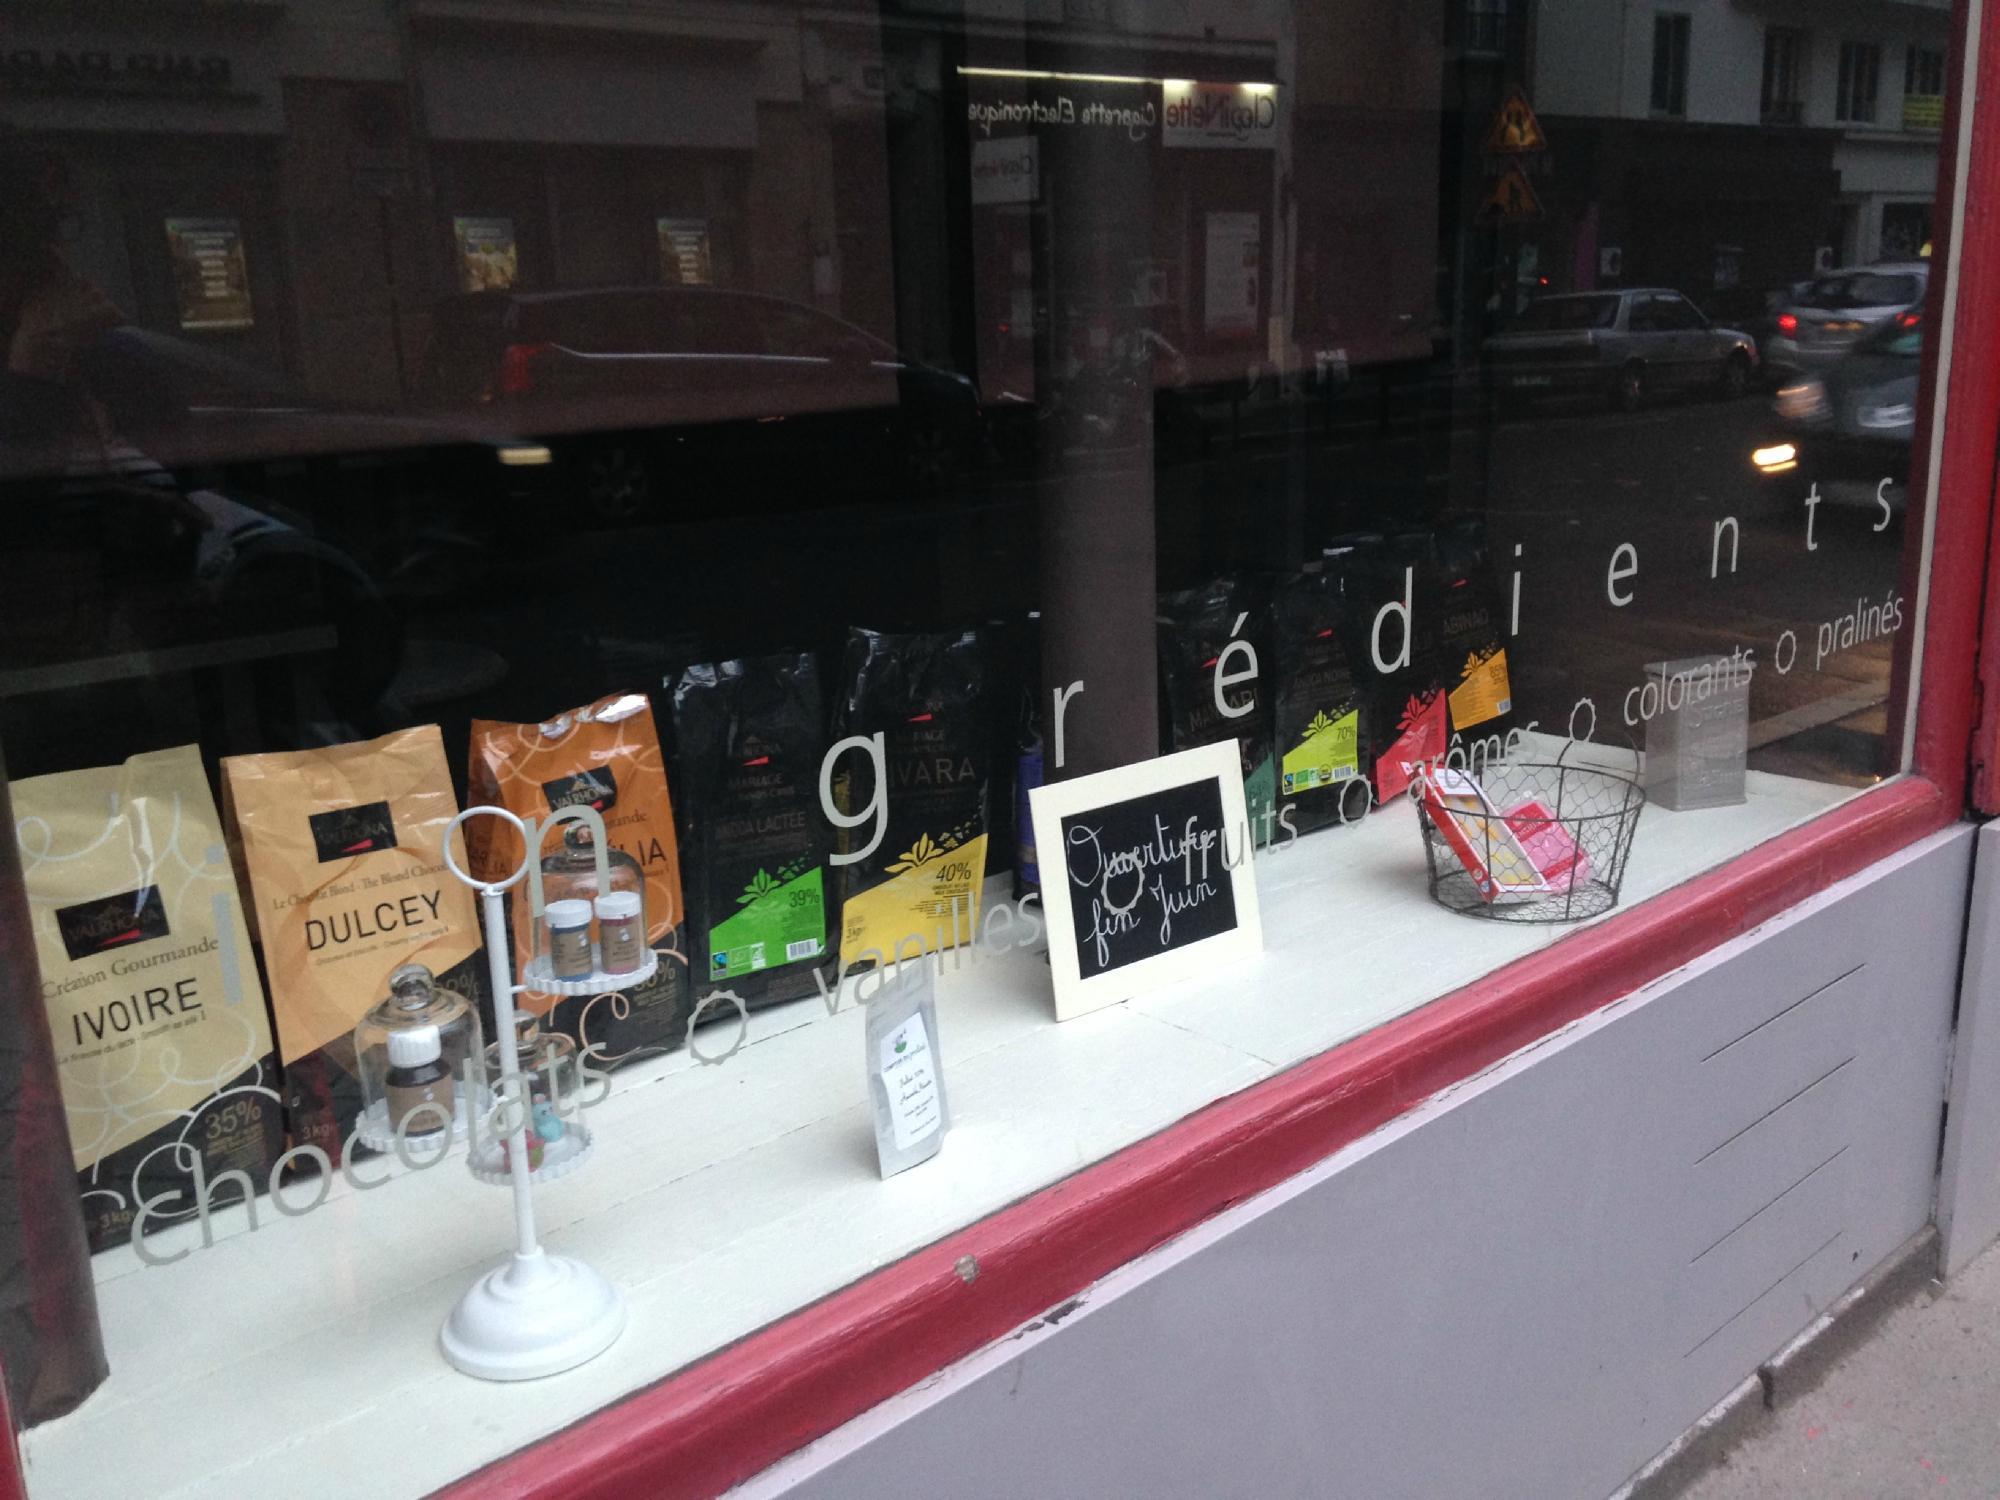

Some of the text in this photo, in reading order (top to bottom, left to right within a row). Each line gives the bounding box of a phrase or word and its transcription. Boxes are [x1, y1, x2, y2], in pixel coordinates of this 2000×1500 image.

[812, 890, 1043, 1017] vanilles
[1408, 716, 1540, 808] arômes
[1623, 643, 1754, 728] colorants
[1816, 589, 1905, 671] pralinés
[788, 887, 820, 909] 39%
[936, 861, 972, 883] 40%
[305, 889, 442, 951] DULCEY
[1083, 897, 1142, 968] fin
[111, 936, 220, 978] Gourmande
[71, 977, 203, 1046] IVOIRE
[204, 1096, 263, 1141] 35%
